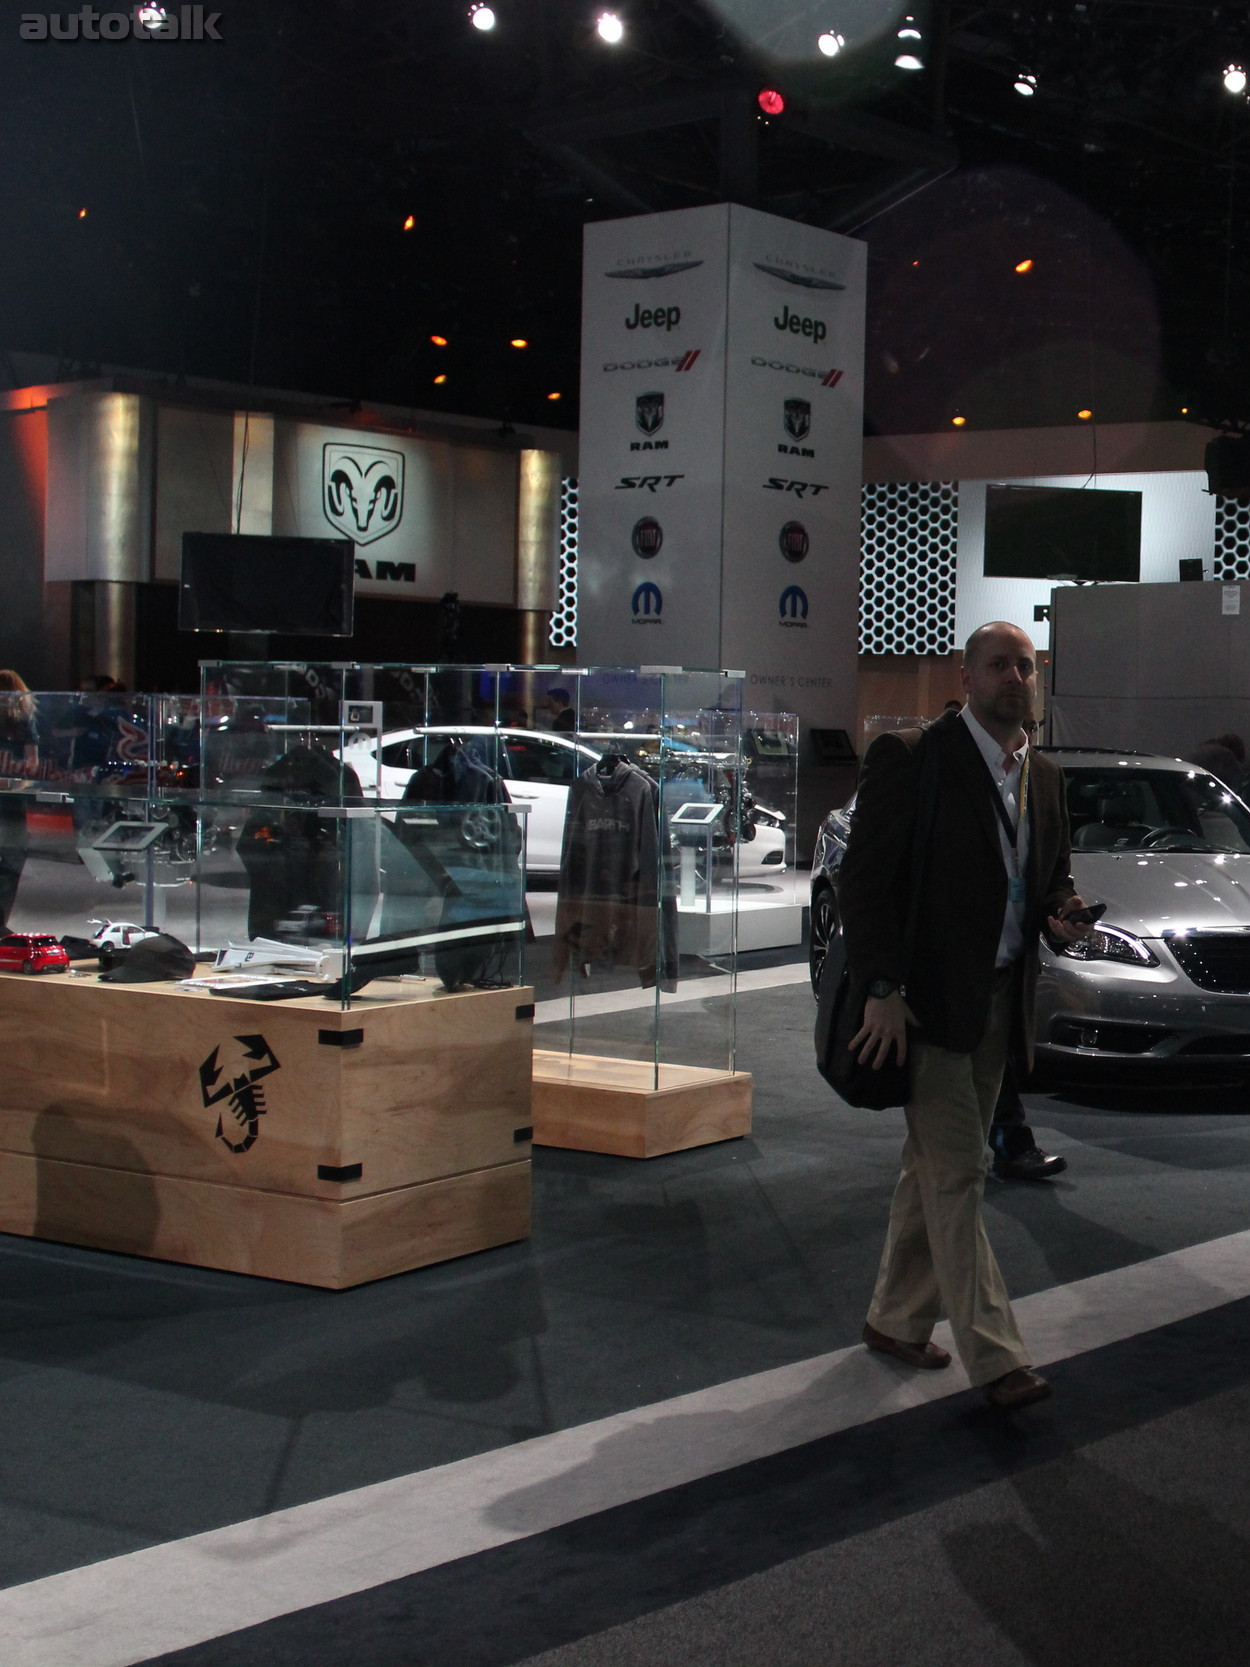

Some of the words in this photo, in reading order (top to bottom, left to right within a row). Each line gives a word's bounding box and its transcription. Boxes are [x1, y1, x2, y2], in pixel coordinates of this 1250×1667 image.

[616, 251, 692, 266] CHRYSLER
[765, 254, 837, 278] CHRYSLER
[625, 303, 681, 331] Jeep
[774, 305, 827, 343] Jeep
[602, 355, 685, 372] DODGE
[751, 355, 830, 379] DODGE
[630, 440, 669, 451] RAM
[777, 443, 815, 458] RAM
[614, 474, 685, 493] SRT
[762, 477, 829, 499] SRT
[355, 559, 416, 582] AM
[751, 674, 796, 686] OWNER'S
[798, 678, 833, 688] CENTER
